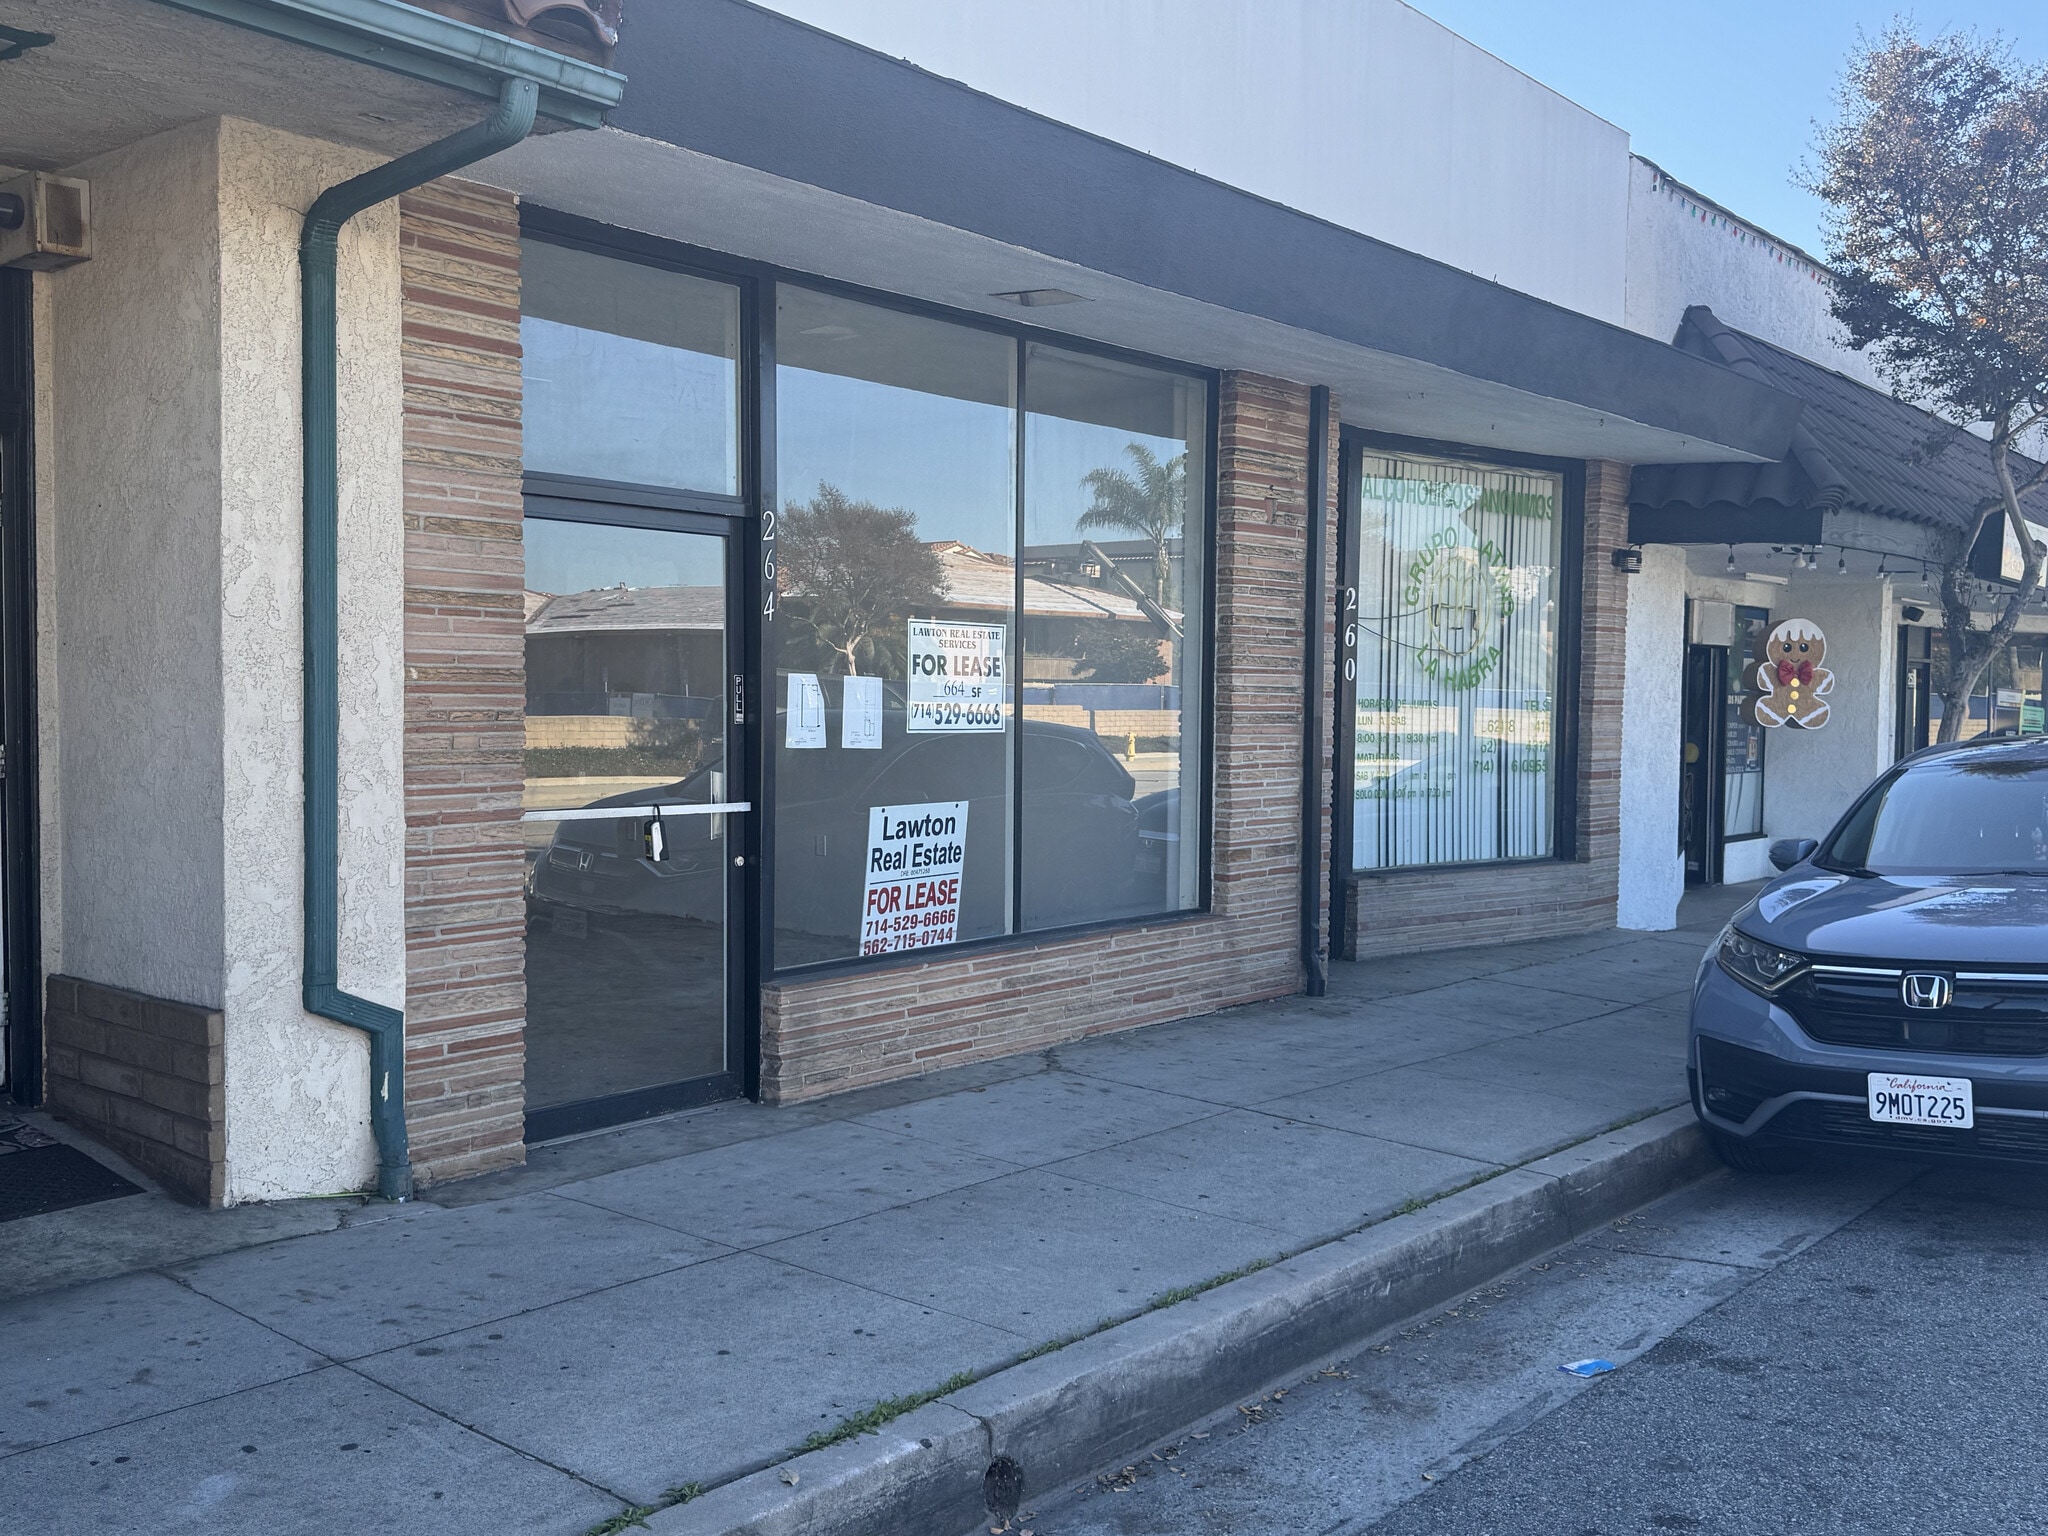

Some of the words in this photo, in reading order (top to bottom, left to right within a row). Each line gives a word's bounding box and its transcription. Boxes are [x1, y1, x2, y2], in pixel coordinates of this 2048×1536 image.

[763, 510, 775, 622] 264
[1405, 527, 1457, 606] GRUPO
[1472, 529, 1515, 616] LATINO
[913, 627, 947, 638] LAWTON
[950, 629, 970, 639] REAL
[973, 631, 1000, 640] ESTATE
[939, 639, 976, 649] SERVICES
[1344, 587, 1356, 681] 260
[912, 653, 947, 676] FOR
[953, 655, 1001, 677] LEASE
[1417, 643, 1439, 681] LA
[1444, 646, 1502, 691] HABRA
[944, 680, 965, 696] 664
[971, 687, 982, 698] SF
[1358, 716, 1372, 725] LUN
[1391, 716, 1406, 725] SAB
[883, 813, 956, 841] Lawton
[871, 844, 907, 873] Real
[912, 841, 962, 867] Estate
[867, 886, 902, 916] FOR
[905, 879, 959, 910] LEASE
[866, 909, 956, 936] 714-529-6666
[863, 927, 953, 956] 562-715-0744
[1889, 1077, 1952, 1092] California
